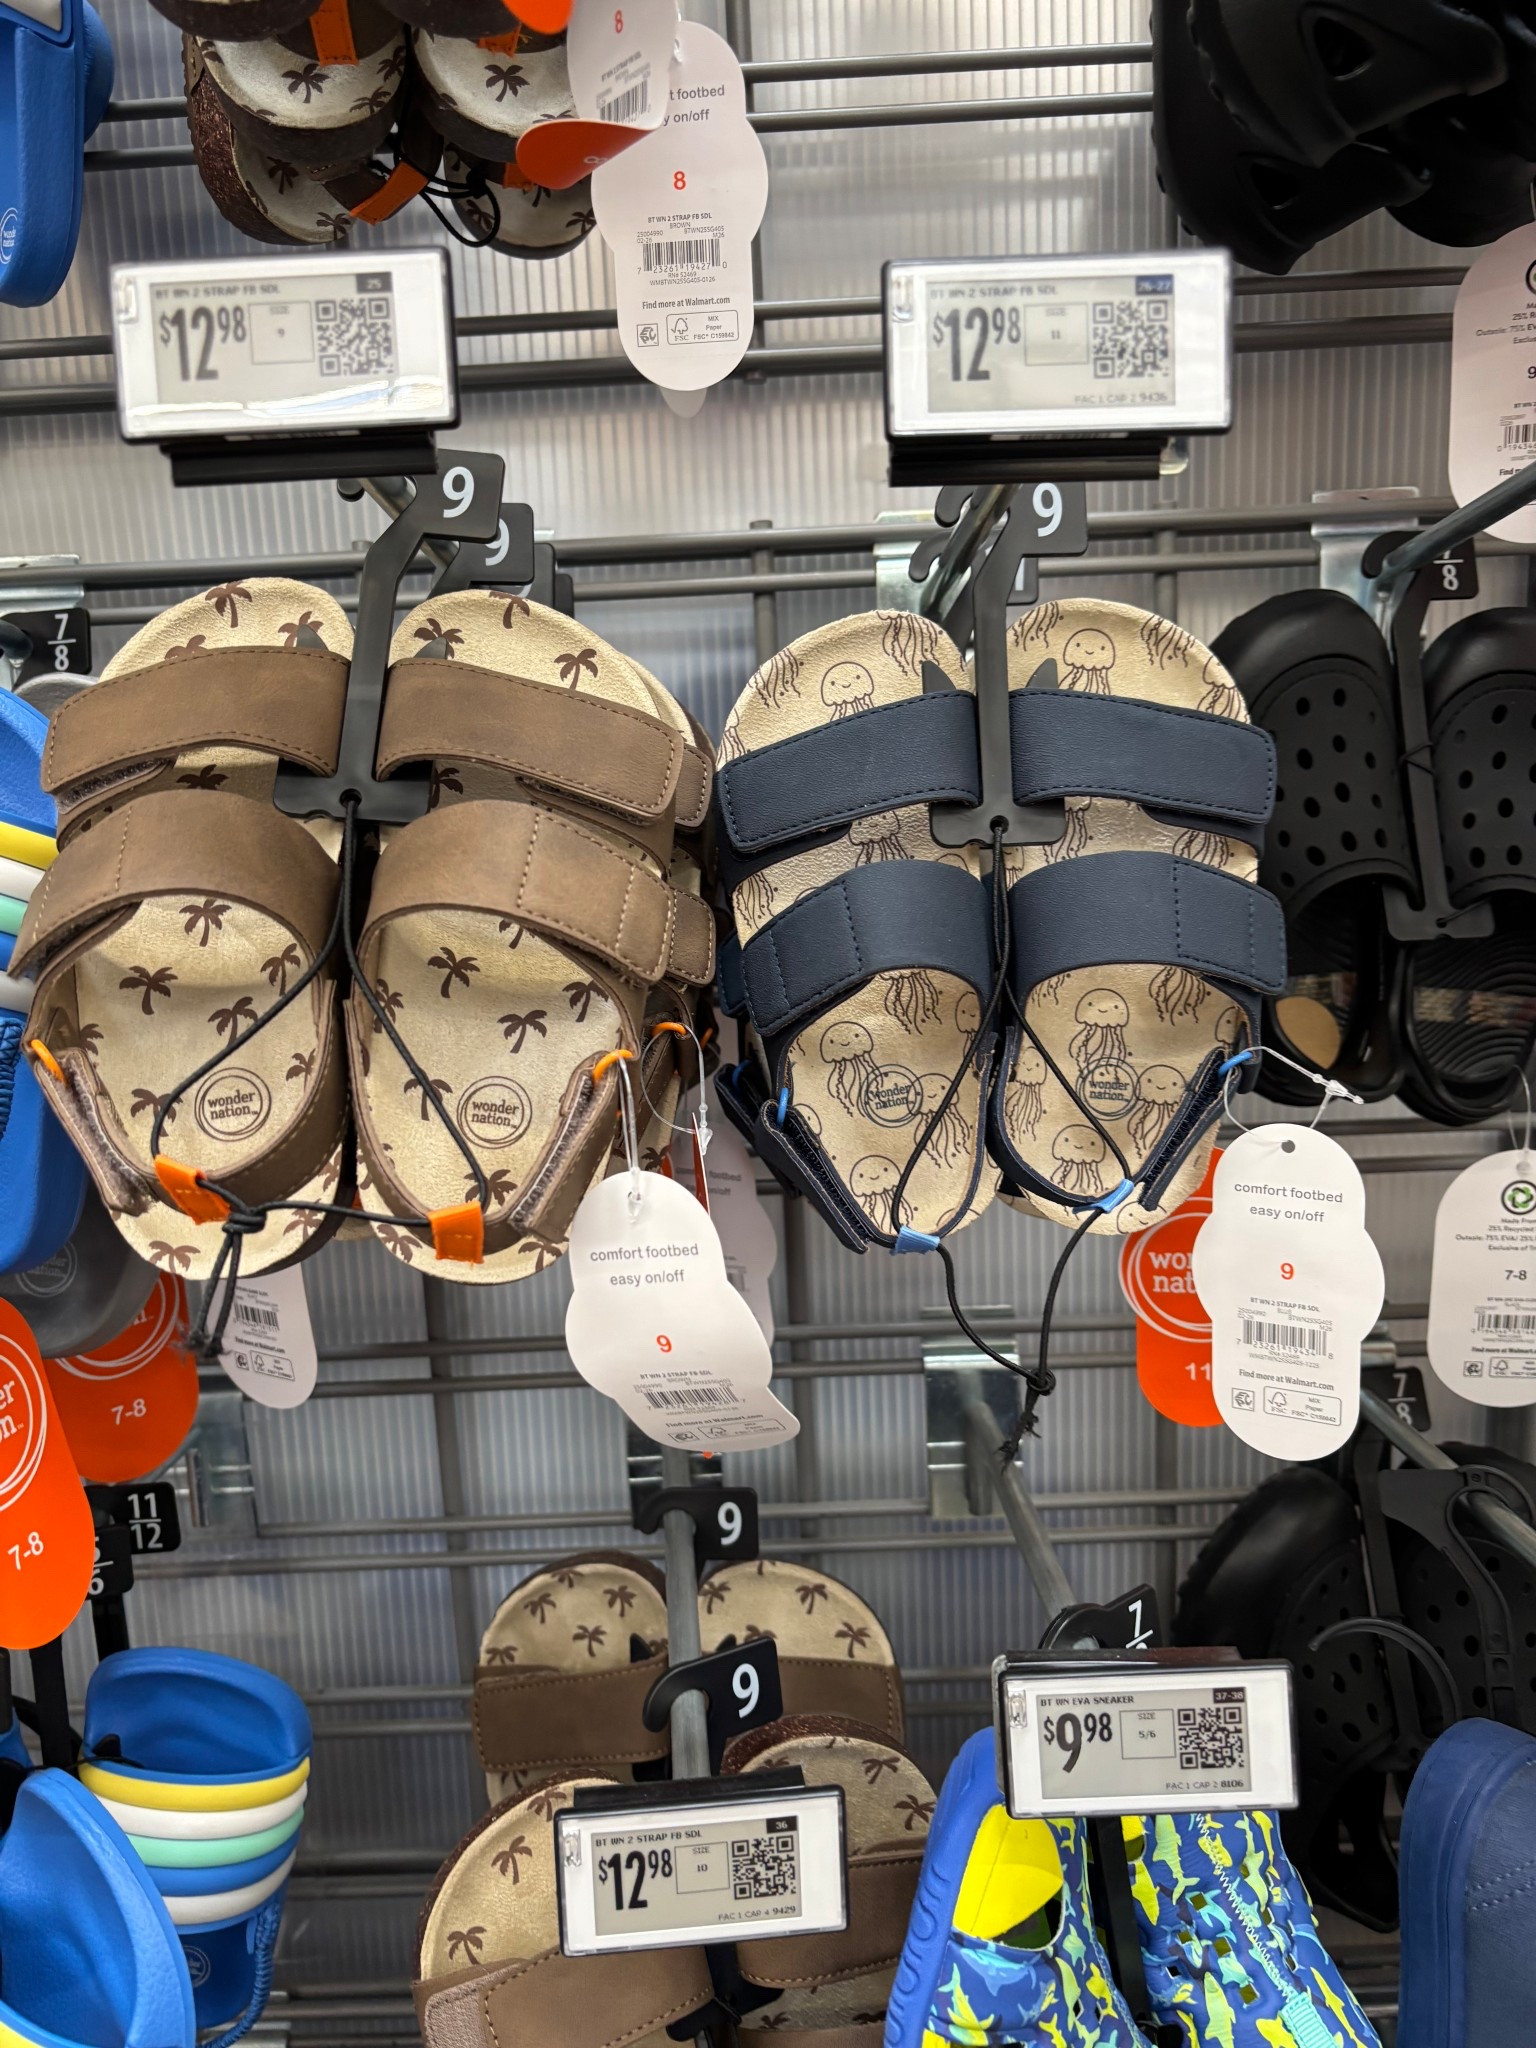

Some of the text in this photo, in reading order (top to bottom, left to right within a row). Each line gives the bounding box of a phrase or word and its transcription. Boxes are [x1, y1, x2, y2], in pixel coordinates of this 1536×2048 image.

[614, 9, 624, 34] 8
[677, 84, 725, 101] footbed
[673, 109, 710, 123] on/off
[673, 170, 686, 191] 8
[671, 213, 691, 222] STRAP
[192, 287, 200, 297] 2
[203, 285, 240, 297] STRAP
[242, 285, 256, 296] FB
[968, 287, 977, 298] 2
[979, 286, 1018, 297] STRAP
[642, 297, 731, 310] Find more at Walmart.com
[443, 466, 475, 518] 9
[1032, 482, 1063, 538] 9
[1441, 564, 1460, 591] 8
[54, 612, 69, 641] 7
[54, 644, 70, 672] 8
[207, 1088, 256, 1108] wonder
[472, 1098, 520, 1115] wonder
[1234, 1181, 1343, 1204] comfort footbed
[1249, 1205, 1325, 1223] easy on/off
[590, 1243, 699, 1262] comfort footbed
[609, 1269, 685, 1288] easy on/off
[1279, 1262, 1295, 1281] 9
[1504, 1269, 1527, 1281] 7-8
[1276, 1300, 1297, 1309] STRAP
[656, 1334, 673, 1353] 9
[1239, 1368, 1335, 1391] Find more at Walmart.com
[1392, 1372, 1408, 1398] 7
[110, 1398, 147, 1426] 7-8
[127, 1492, 159, 1519] 11
[717, 1501, 743, 1546] 9
[130, 1522, 164, 1550] 12
[7, 1531, 44, 1571] 7-8
[1128, 1599, 1143, 1638] 7
[732, 1662, 760, 1719] 9
[1040, 1691, 1244, 1707] BT WN EVA SNEAKER 37-38
[1137, 1712, 1156, 1720] SIZE
[1192, 1781, 1209, 1789] CAP
[1220, 1779, 1244, 1789] 8106
[595, 1838, 608, 1847] BT
[610, 1836, 626, 1846] WN
[627, 1836, 635, 1844] 2
[636, 1833, 668, 1844] STRAP
[670, 1831, 682, 1840] FB
[685, 1830, 703, 1840] SDL
[696, 1864, 708, 1873] 10
[745, 1909, 762, 1919] CAP
